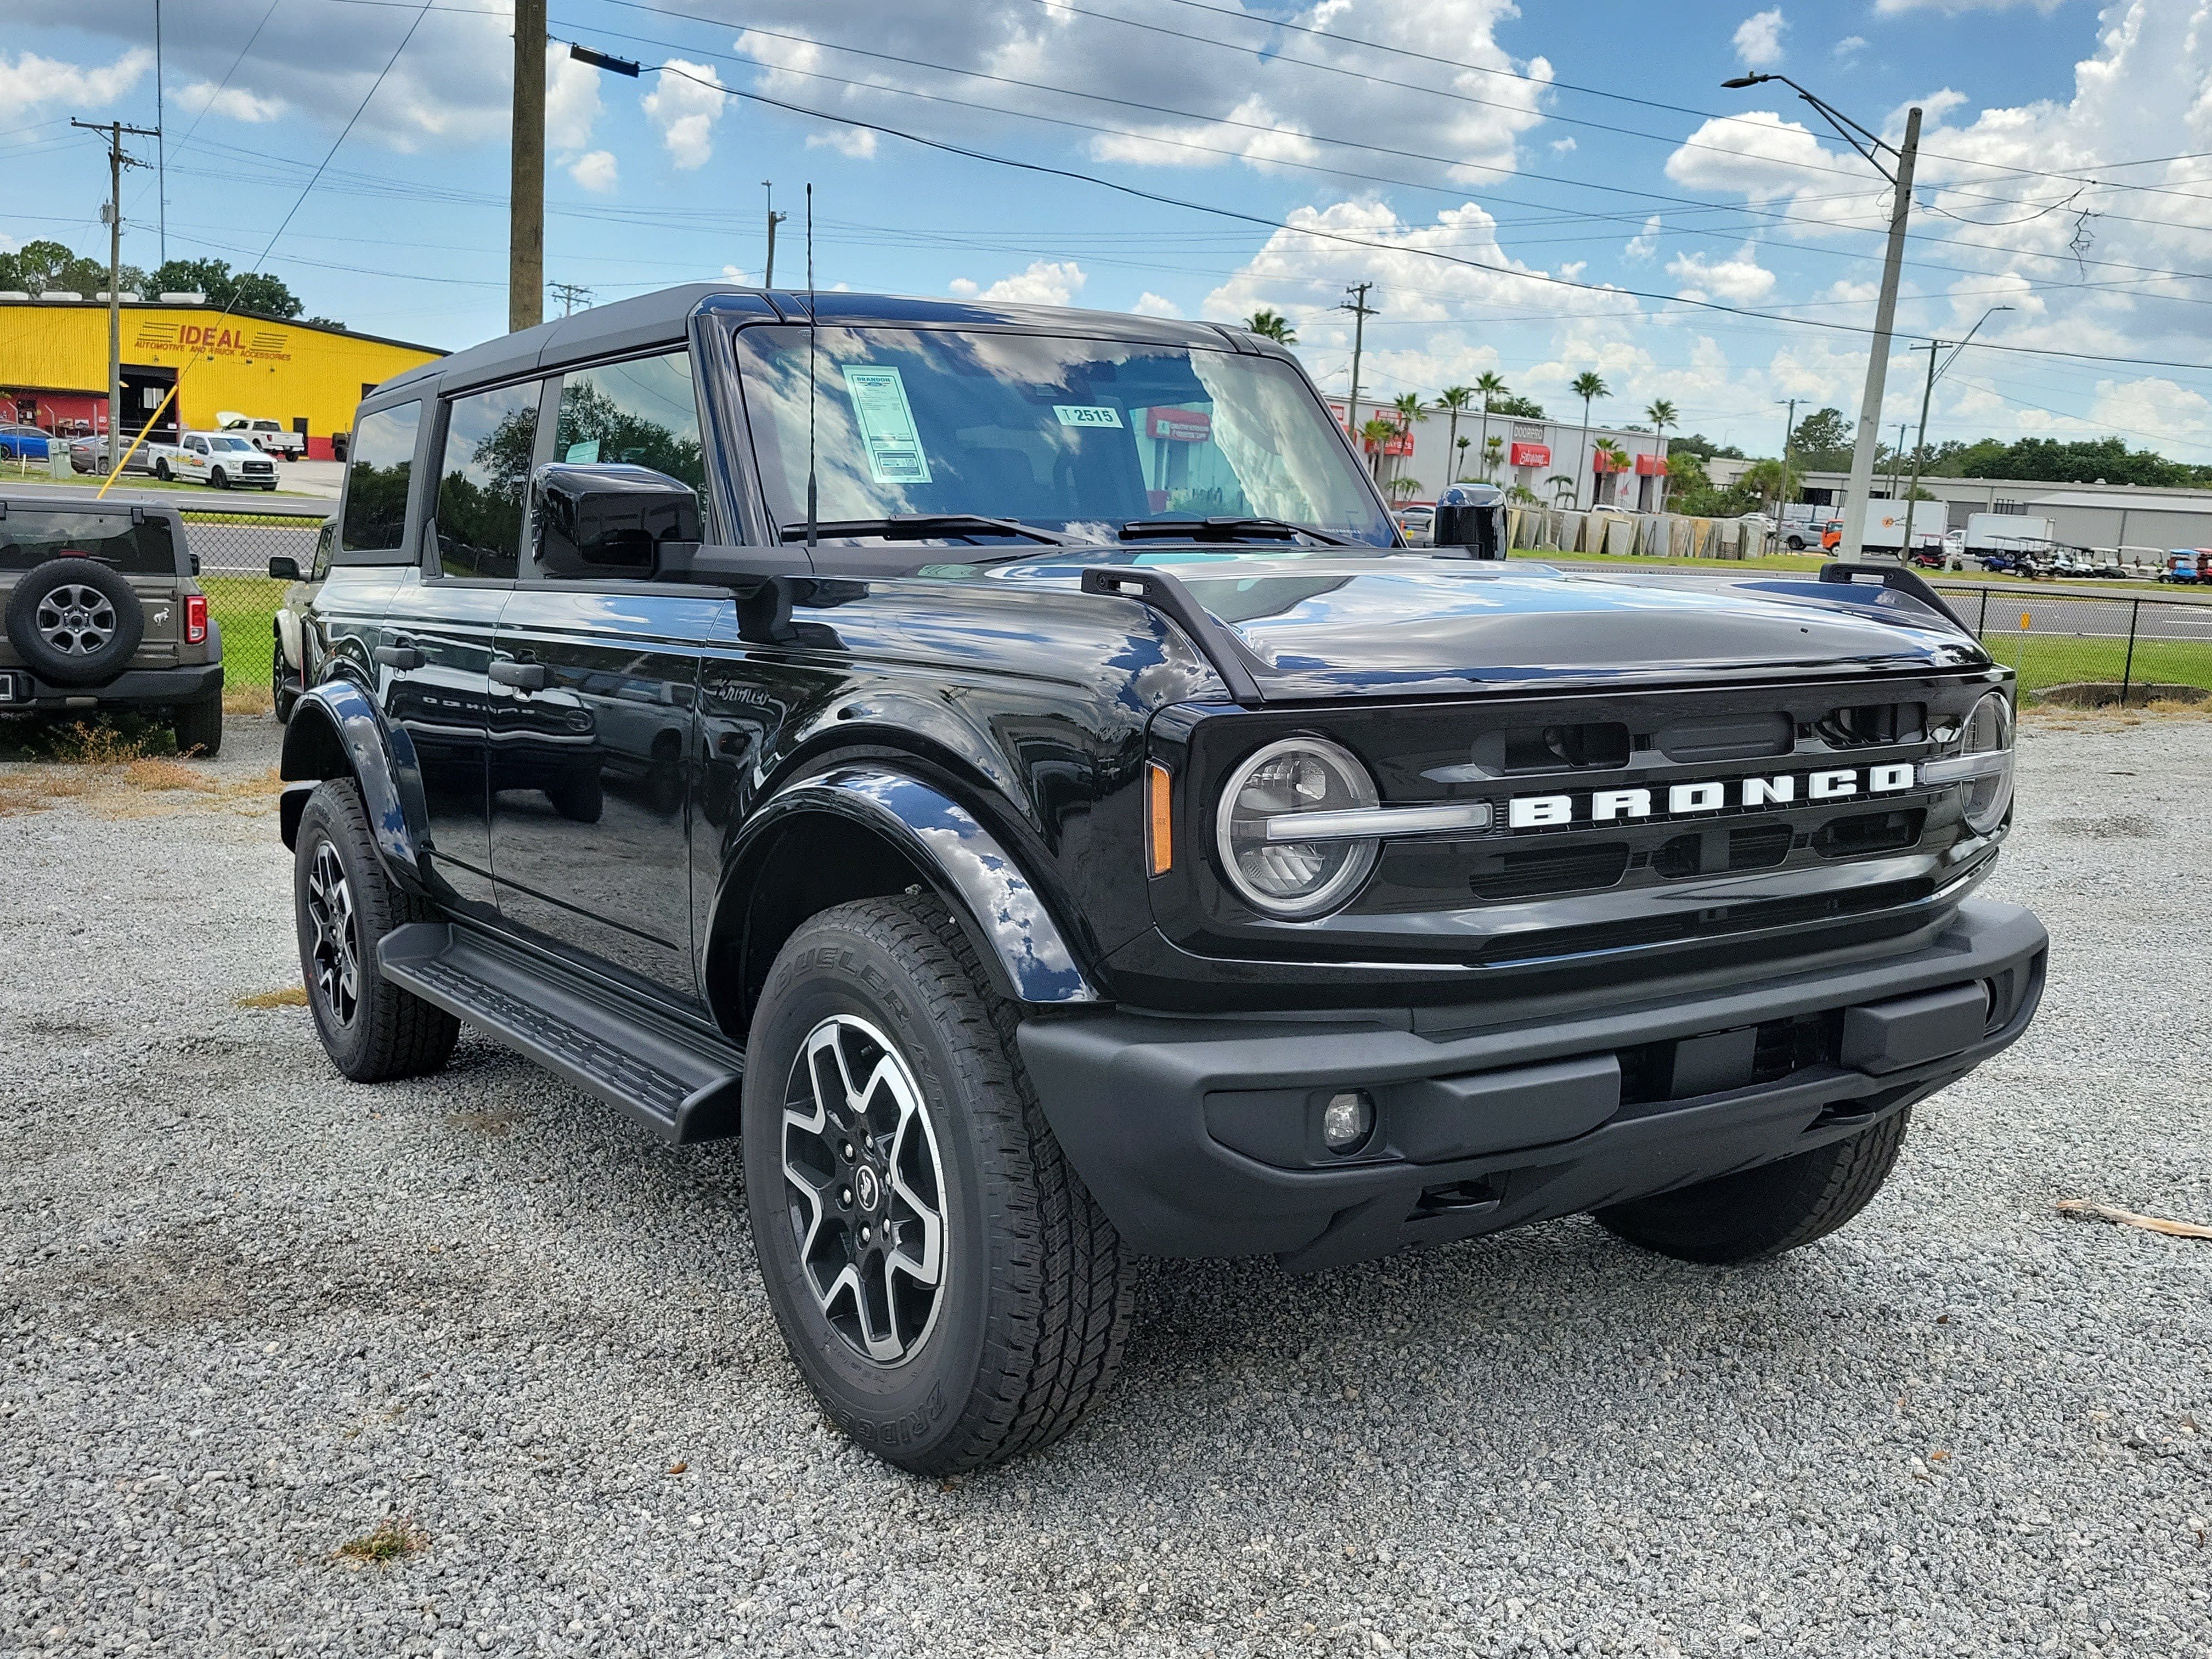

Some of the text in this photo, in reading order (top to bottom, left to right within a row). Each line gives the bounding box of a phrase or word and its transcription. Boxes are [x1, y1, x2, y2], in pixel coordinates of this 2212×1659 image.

[178, 325, 246, 349] IDEAL
[134, 341, 291, 361] AUTOMOTIVE AND TRUCK ACCESSORIES
[1074, 409, 1113, 422] 2515
[1509, 763, 1914, 829] BRONCO
